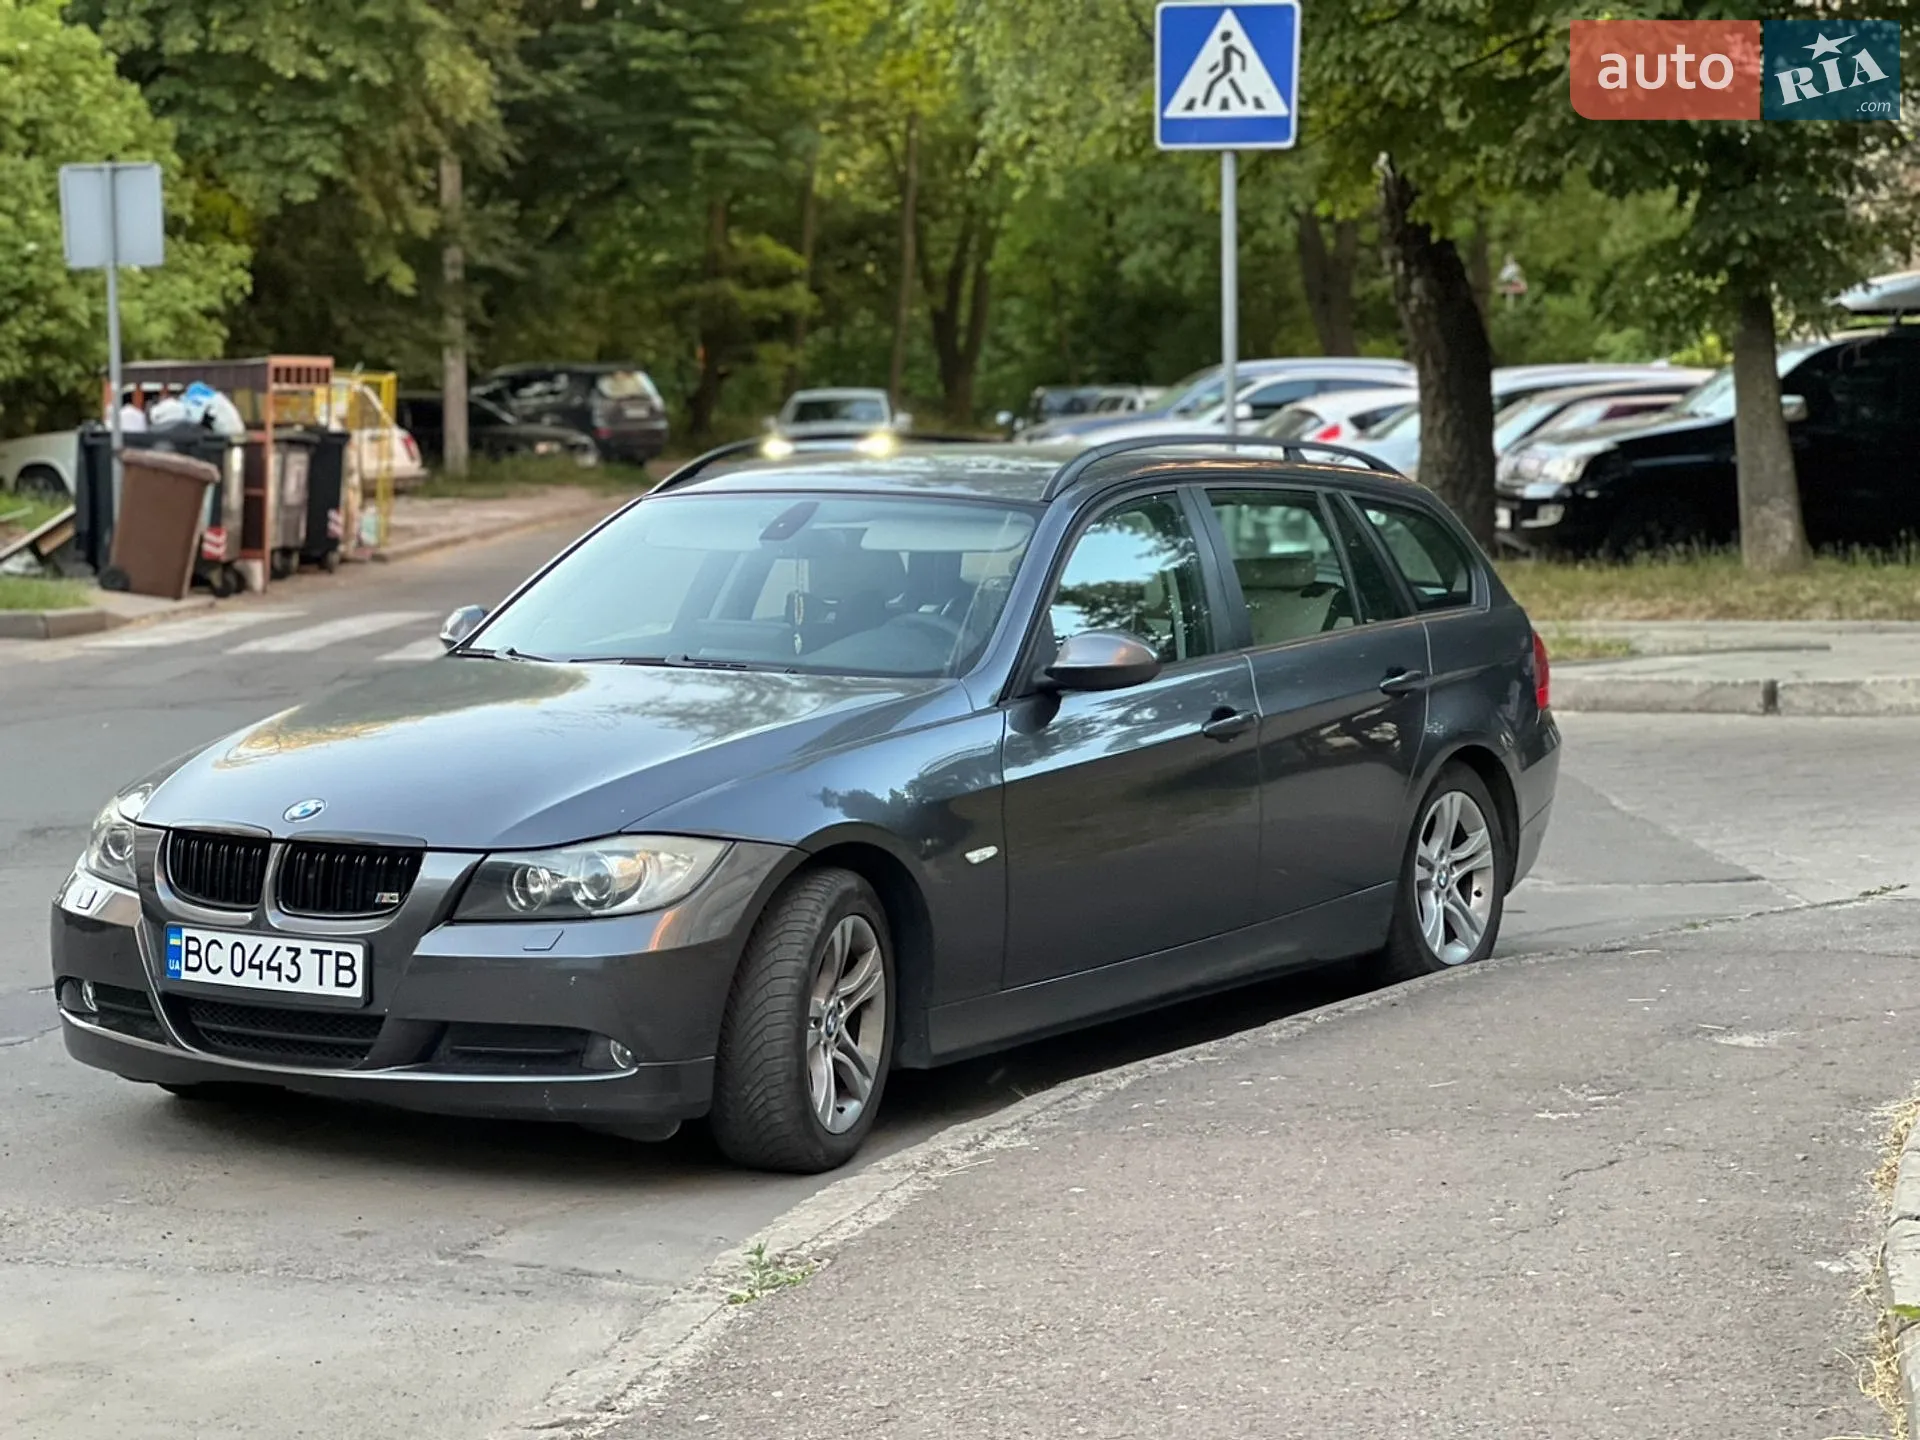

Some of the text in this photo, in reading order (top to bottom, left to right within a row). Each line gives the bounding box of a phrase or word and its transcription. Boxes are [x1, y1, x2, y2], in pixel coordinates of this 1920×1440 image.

[168, 959, 181, 971] UA
[184, 935, 358, 989] BC 0443 TB
